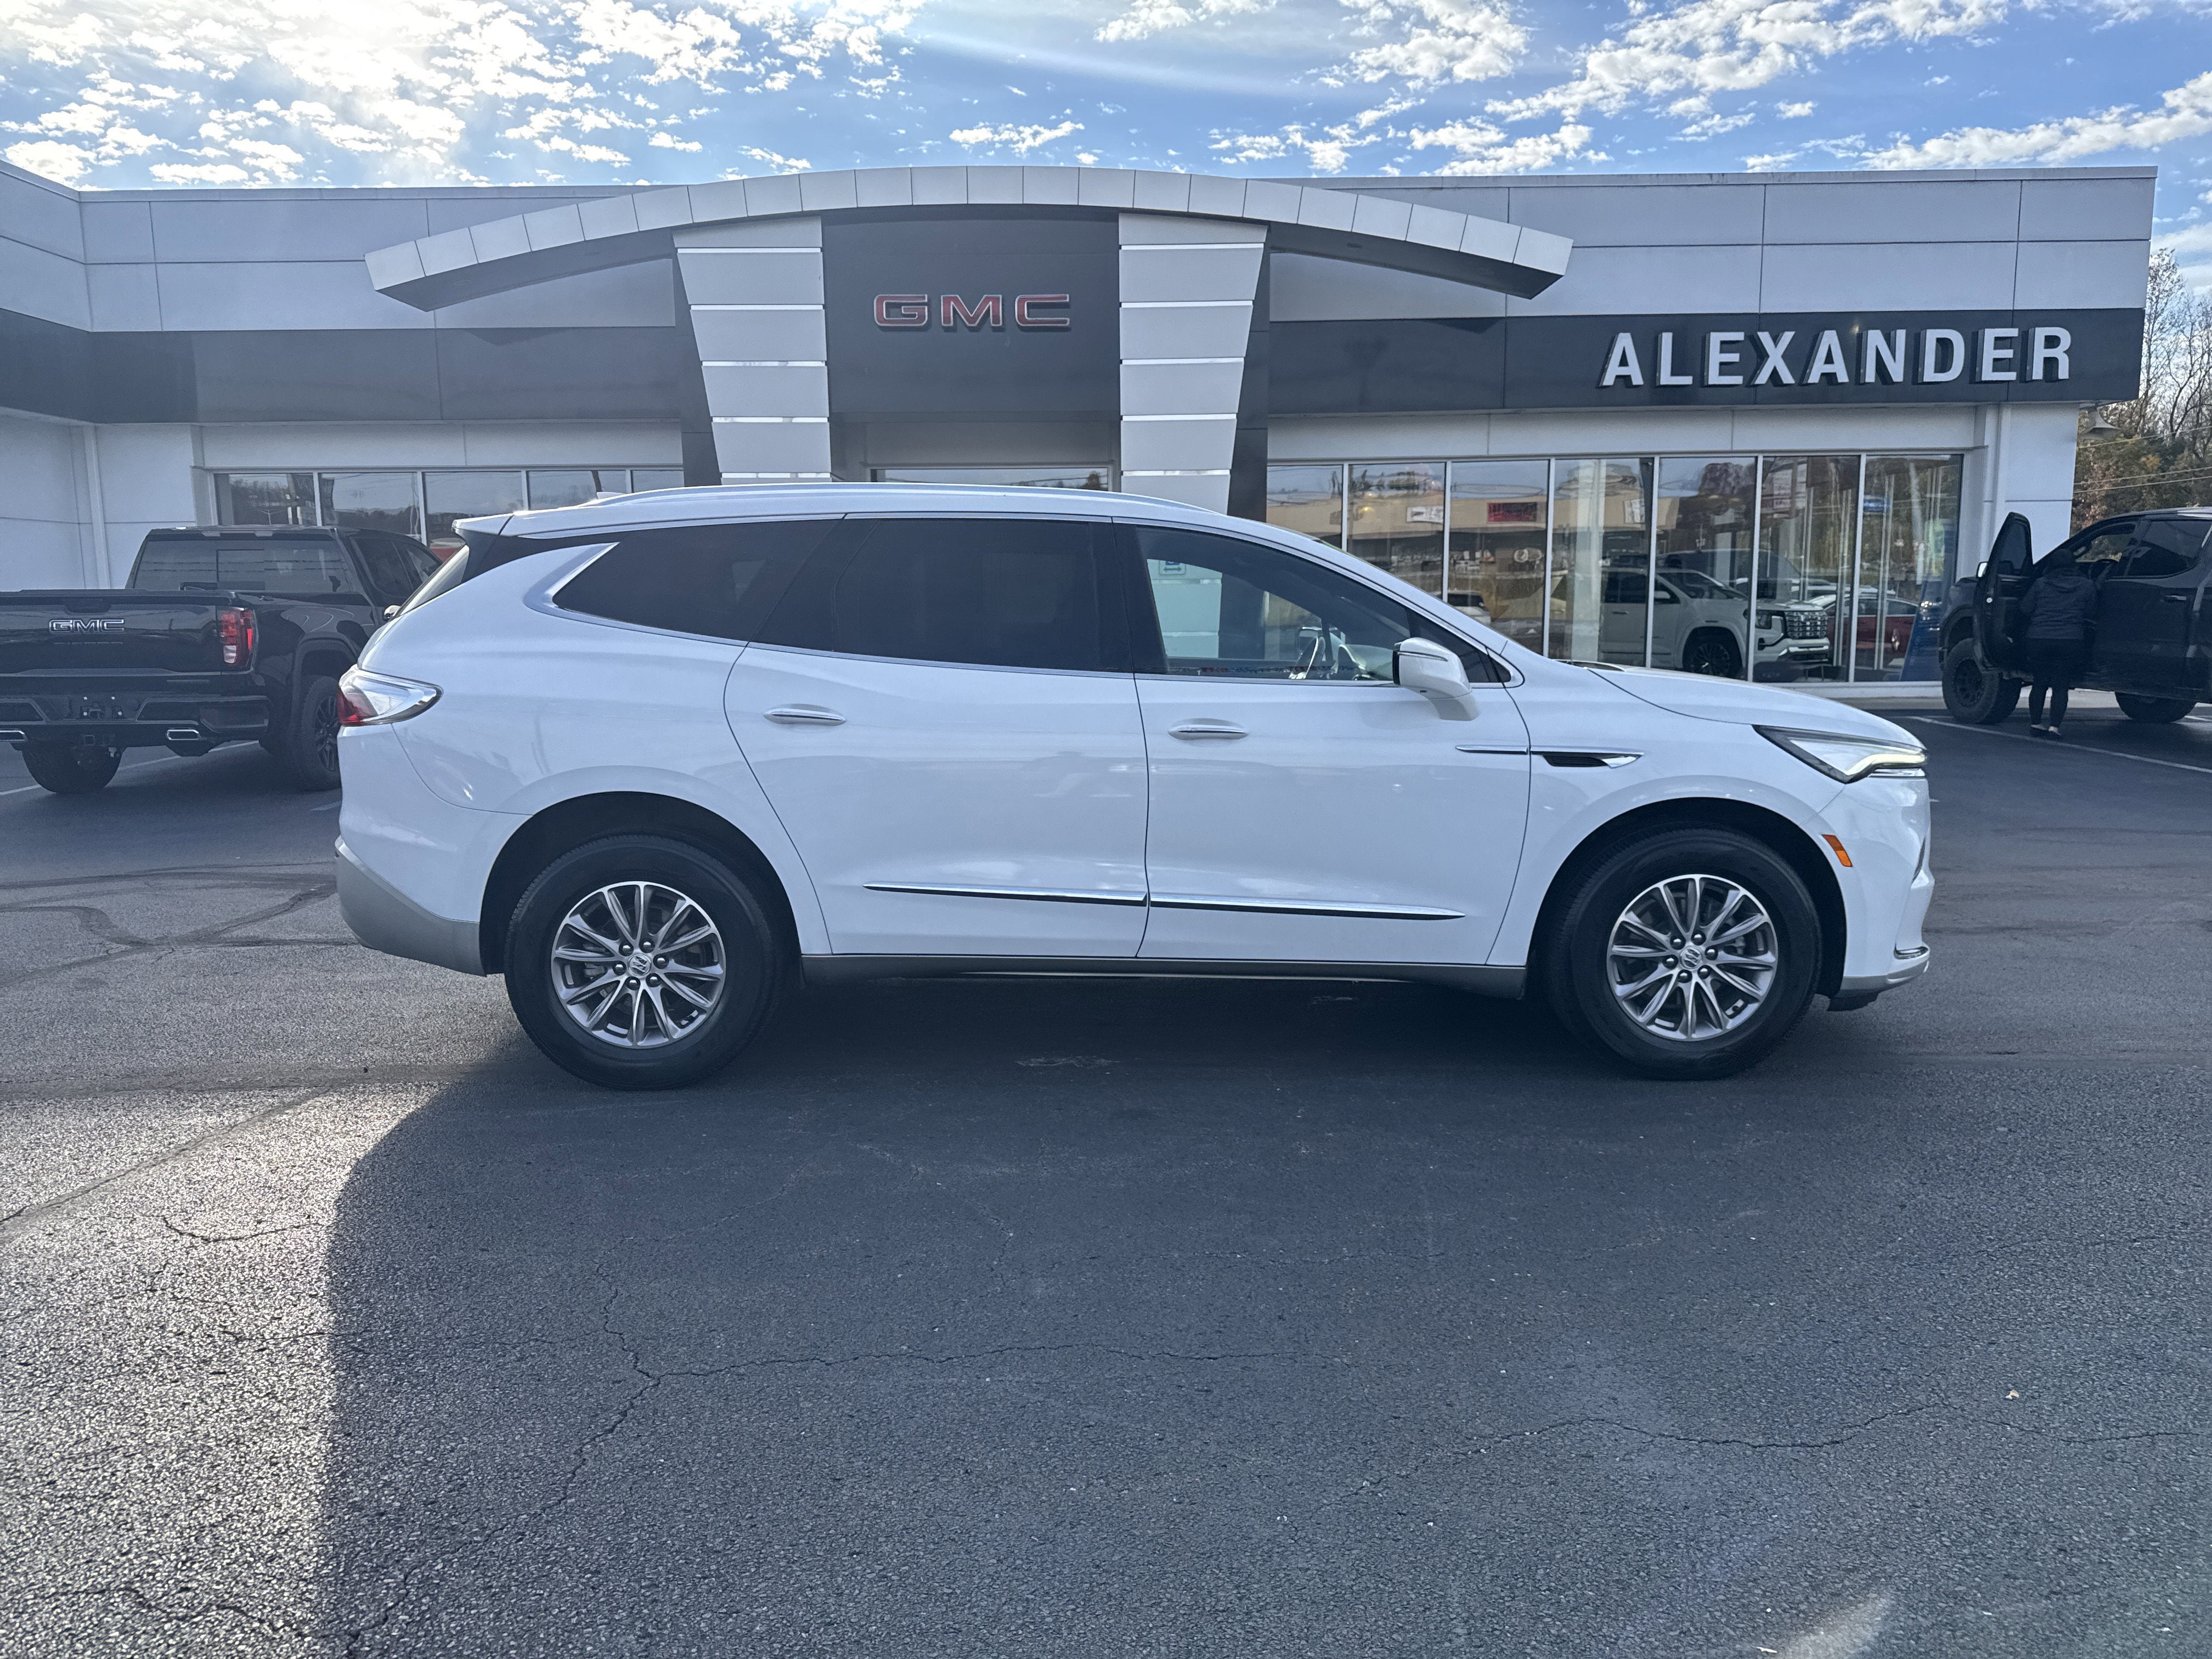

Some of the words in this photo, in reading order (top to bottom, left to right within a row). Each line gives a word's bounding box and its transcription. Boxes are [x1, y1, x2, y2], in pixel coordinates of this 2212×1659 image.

[874, 294, 1070, 327] GMC
[1600, 327, 2071, 386] ALEXANDER
[49, 619, 125, 634] GMC
